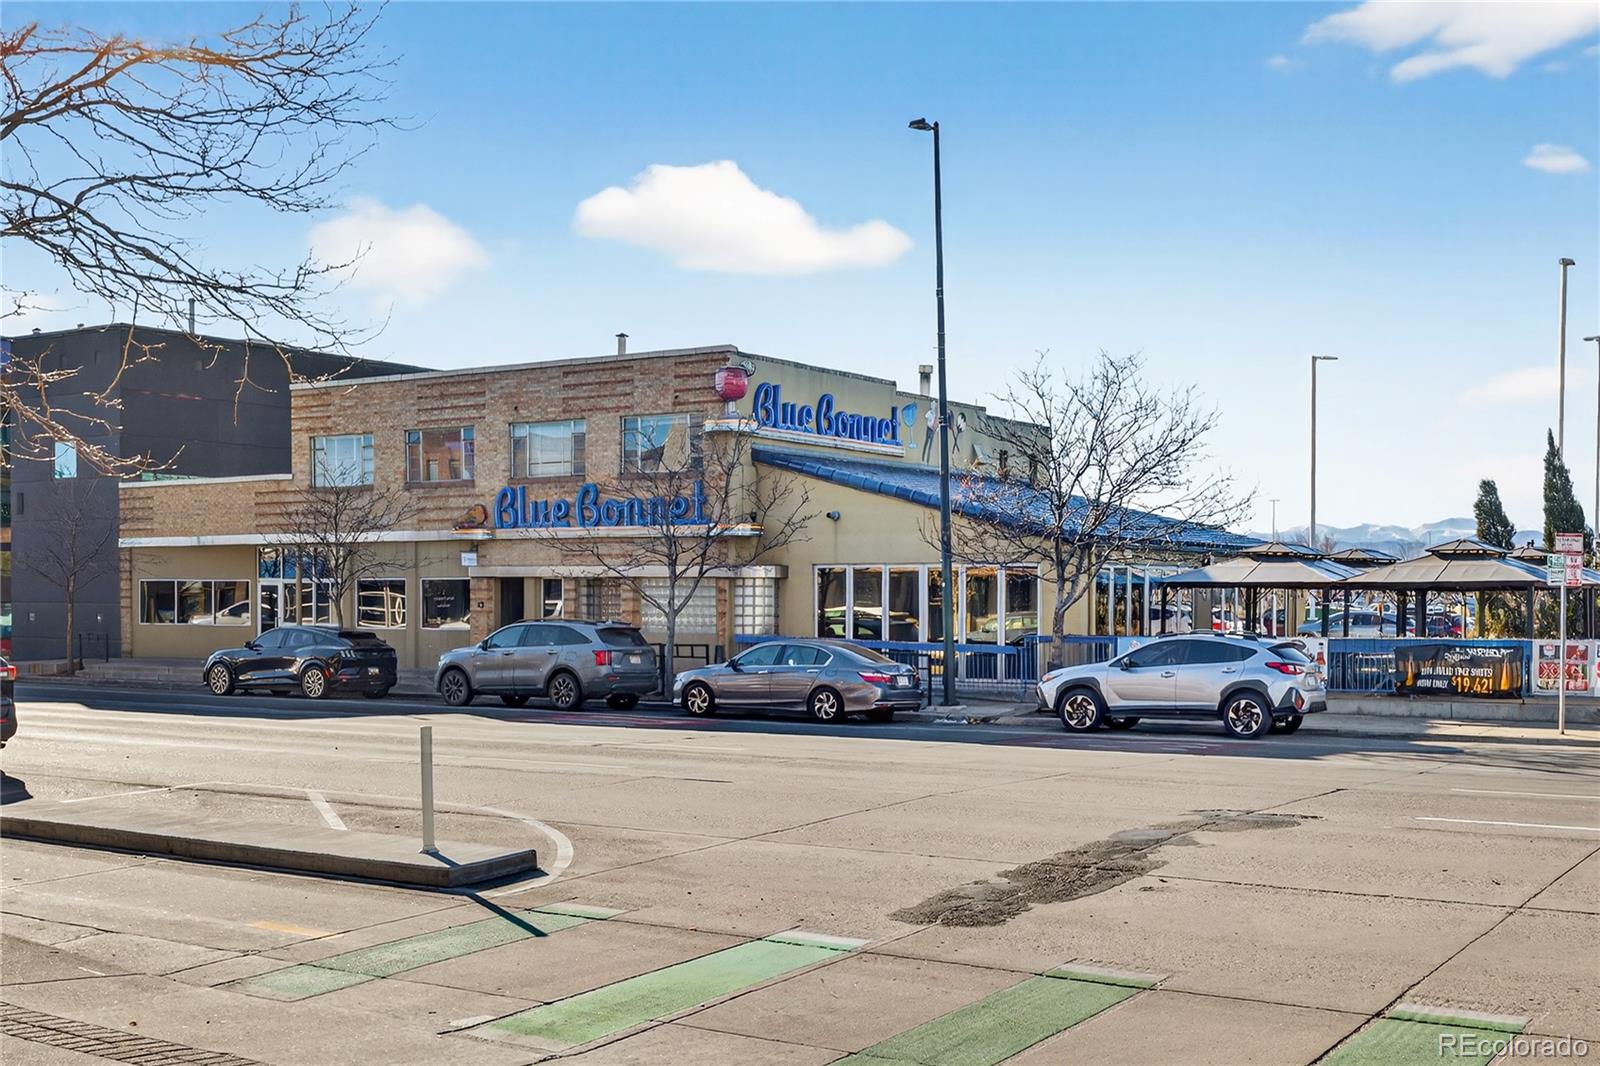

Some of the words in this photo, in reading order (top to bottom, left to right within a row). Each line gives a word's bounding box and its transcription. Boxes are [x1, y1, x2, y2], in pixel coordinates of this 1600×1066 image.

[753, 382, 816, 434] Blue
[816, 393, 903, 446] Bonnet
[494, 485, 571, 528] Blue
[576, 480, 711, 528] Bonnet
